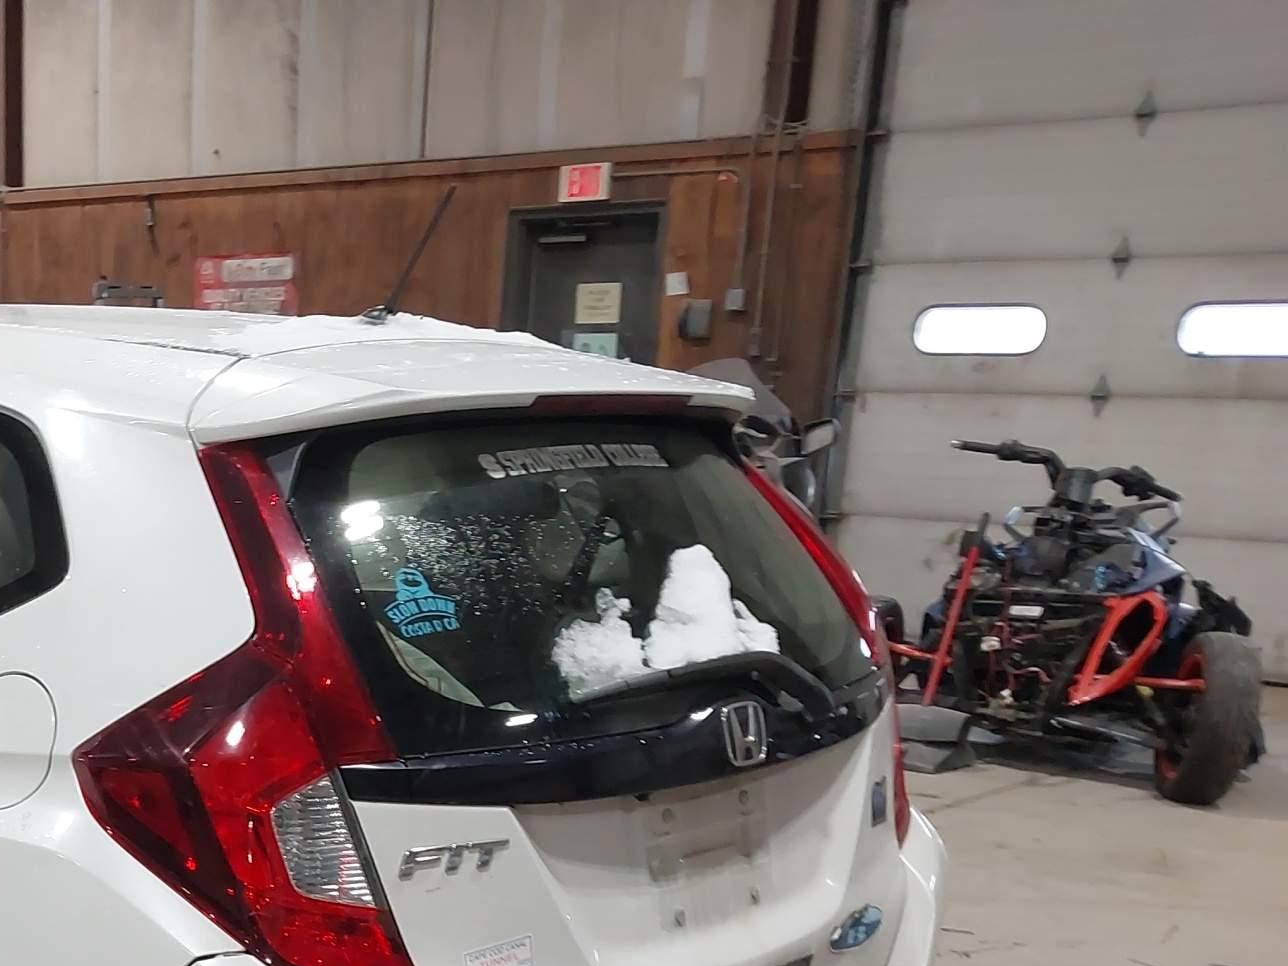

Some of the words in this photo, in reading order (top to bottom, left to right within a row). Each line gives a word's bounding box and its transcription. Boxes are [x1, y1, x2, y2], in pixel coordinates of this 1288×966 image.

[386, 600, 420, 625] SLOW
[400, 620, 435, 638] COSTA
[397, 838, 511, 882] FIT
